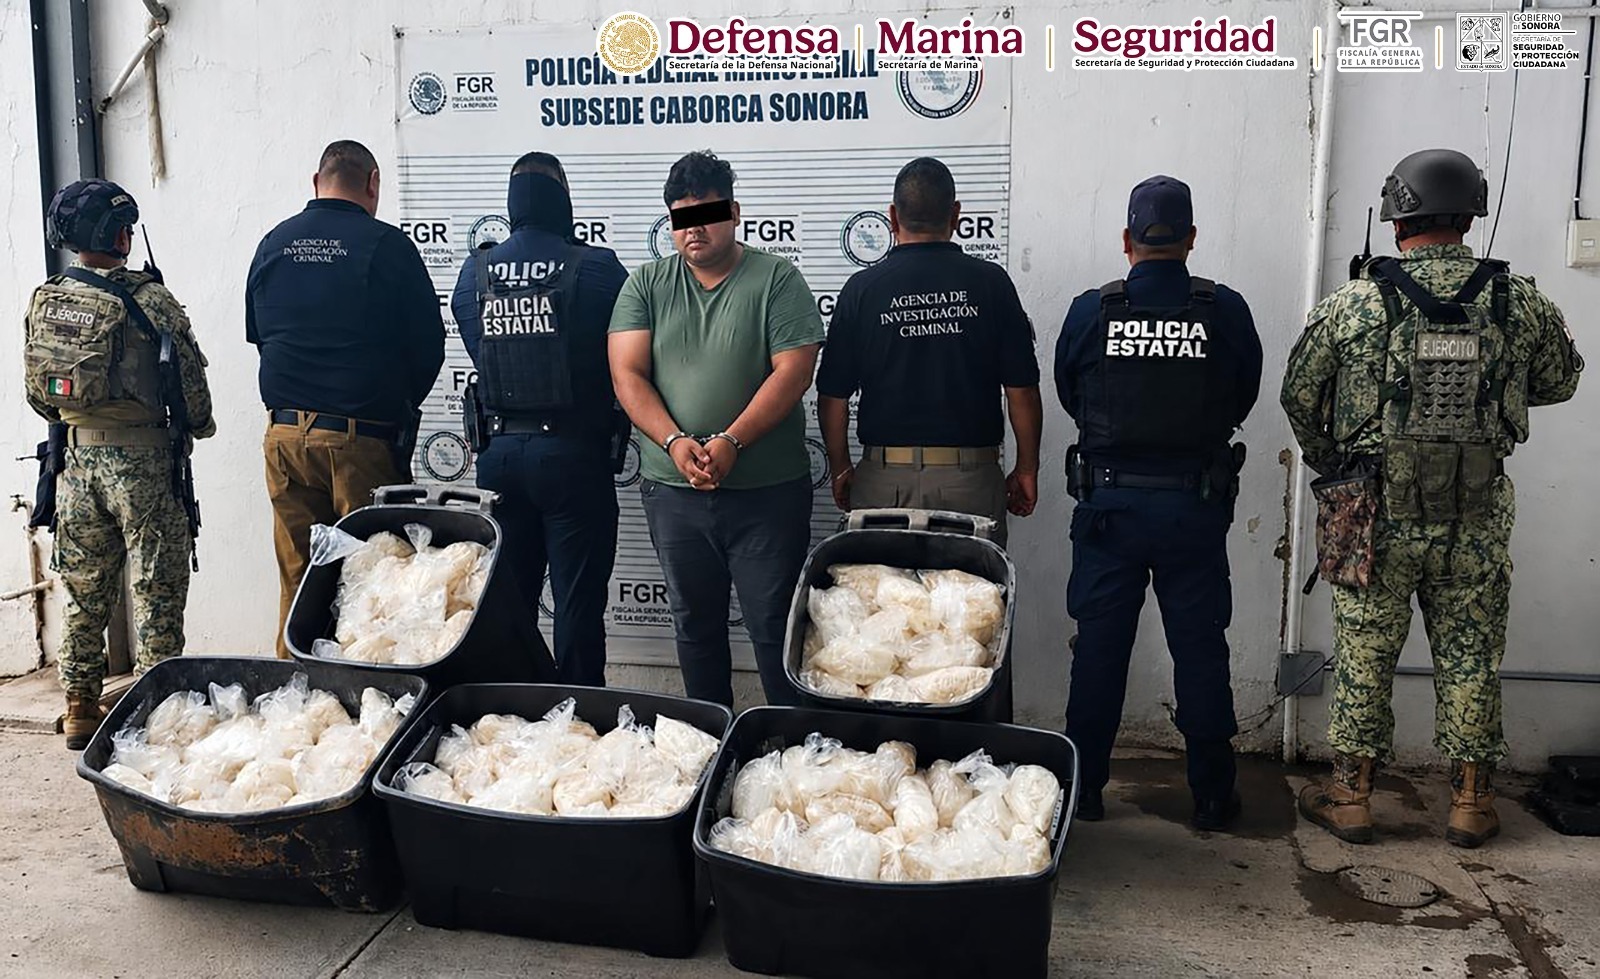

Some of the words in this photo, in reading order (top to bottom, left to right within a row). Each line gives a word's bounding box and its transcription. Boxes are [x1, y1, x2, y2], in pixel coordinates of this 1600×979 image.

[456, 76, 494, 94] FGR
[540, 96, 644, 127] SUBSEDE
[650, 94, 764, 126] CABORCA
[769, 91, 869, 122] SONORA
[572, 221, 608, 243] GR
[743, 219, 796, 242] FGR
[956, 216, 995, 239] GR
[291, 238, 328, 247] AGENCIA
[768, 246, 802, 254] GENERAL
[964, 243, 1001, 252] GENERAL
[890, 292, 948, 309] AGENCIA
[949, 290, 967, 302] DE
[880, 302, 979, 325] INVESTIGACIÓN
[483, 315, 555, 336] ESTATAL
[899, 321, 963, 337] CRIMINAL
[1106, 338, 1206, 358] ESTATAL
[619, 583, 669, 604] FGR
